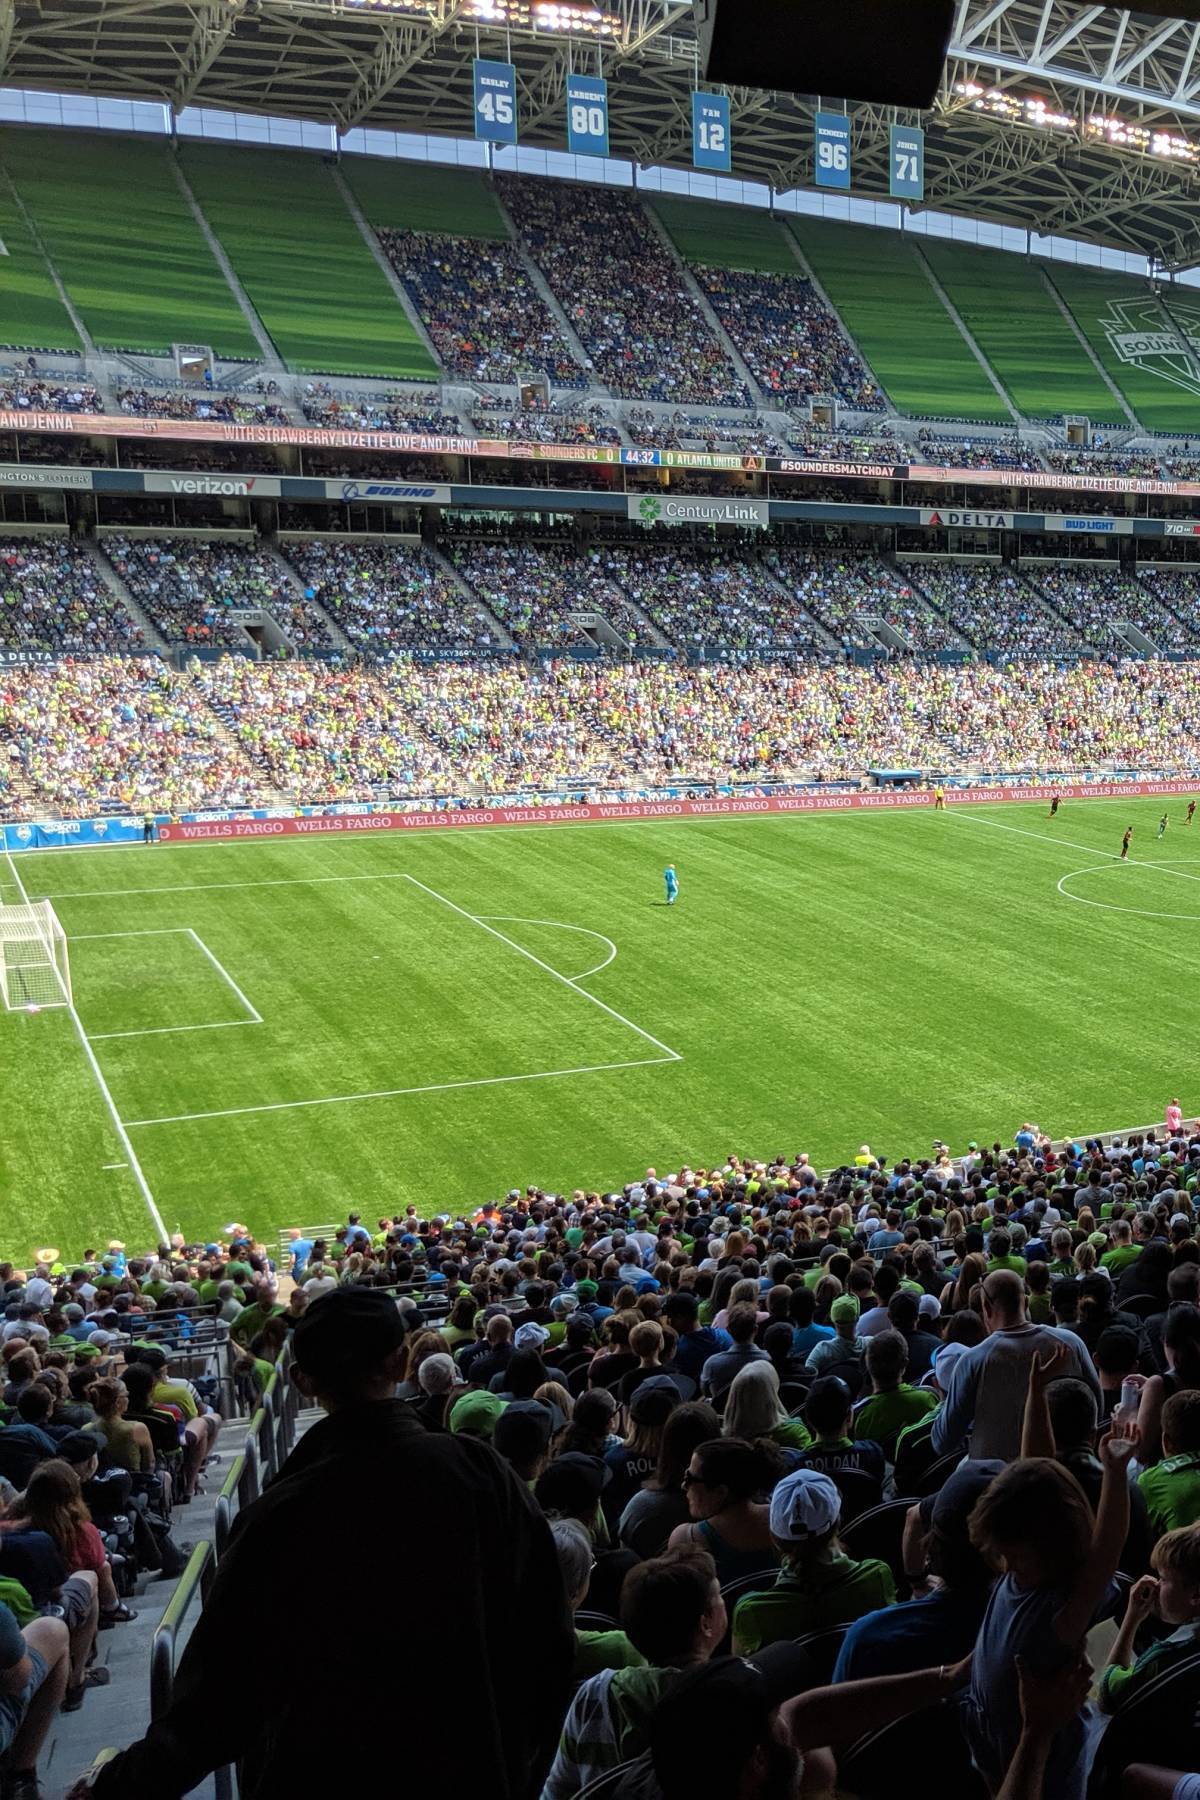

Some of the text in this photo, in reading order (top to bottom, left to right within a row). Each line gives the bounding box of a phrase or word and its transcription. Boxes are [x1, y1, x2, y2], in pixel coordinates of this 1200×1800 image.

[477, 92, 513, 124] 45
[702, 108, 721, 118] FAN
[571, 105, 605, 136] 80
[699, 122, 725, 151] 12
[818, 128, 848, 139] KENNEDY
[896, 141, 918, 151] JONES
[819, 142, 848, 171] 96
[895, 154, 919, 182] 71
[0, 413, 73, 430] AND JENNA
[223, 425, 255, 442] WITH
[342, 431, 387, 448] LIZETTE
[389, 433, 417, 450] LOVE
[420, 436, 443, 451] AND
[446, 438, 479, 454] JENNA
[540, 445, 613, 461] SOUNDERS FC 0
[626, 450, 654, 464] 44:32
[667, 452, 741, 468] 0 ATLANTA UNITED
[781, 460, 895, 477] #SOUNDERSMATCHDAY
[48, 475, 91, 484] LOTTERY
[171, 477, 249, 495] verizon
[1001, 472, 1022, 485] WITH
[1081, 477, 1113, 490] LIZETTE
[1114, 479, 1134, 491] LOVE
[1136, 480, 1151, 492] AND
[1153, 482, 1178, 493] JENNA
[365, 486, 437, 498] BOEING
[666, 502, 759, 521] CenturyLink
[948, 513, 1007, 527] DELTA
[1065, 520, 1115, 530] BUD LIGHT
[1166, 524, 1183, 533] 710
[233, 612, 261, 620] 206
[8, 652, 53, 661] DELTA
[1011, 789, 1042, 799] WELLS
[1081, 785, 1141, 796] WELLS FARGO
[1147, 784, 1176, 793] WELLS
[778, 797, 852, 809] WELLS FARGO
[859, 794, 929, 805] WELLS FARGO
[940, 791, 1004, 802] ELLS FARGO
[599, 804, 682, 817] WELLS FARGO
[690, 800, 769, 813] WELLS FARGO
[401, 813, 493, 826] WELLS FARGO
[504, 808, 590, 822] WELLS FARGO
[182, 825, 232, 837] WELLS
[236, 823, 284, 836] FARGO
[295, 818, 392, 832] WELLS FARGO
